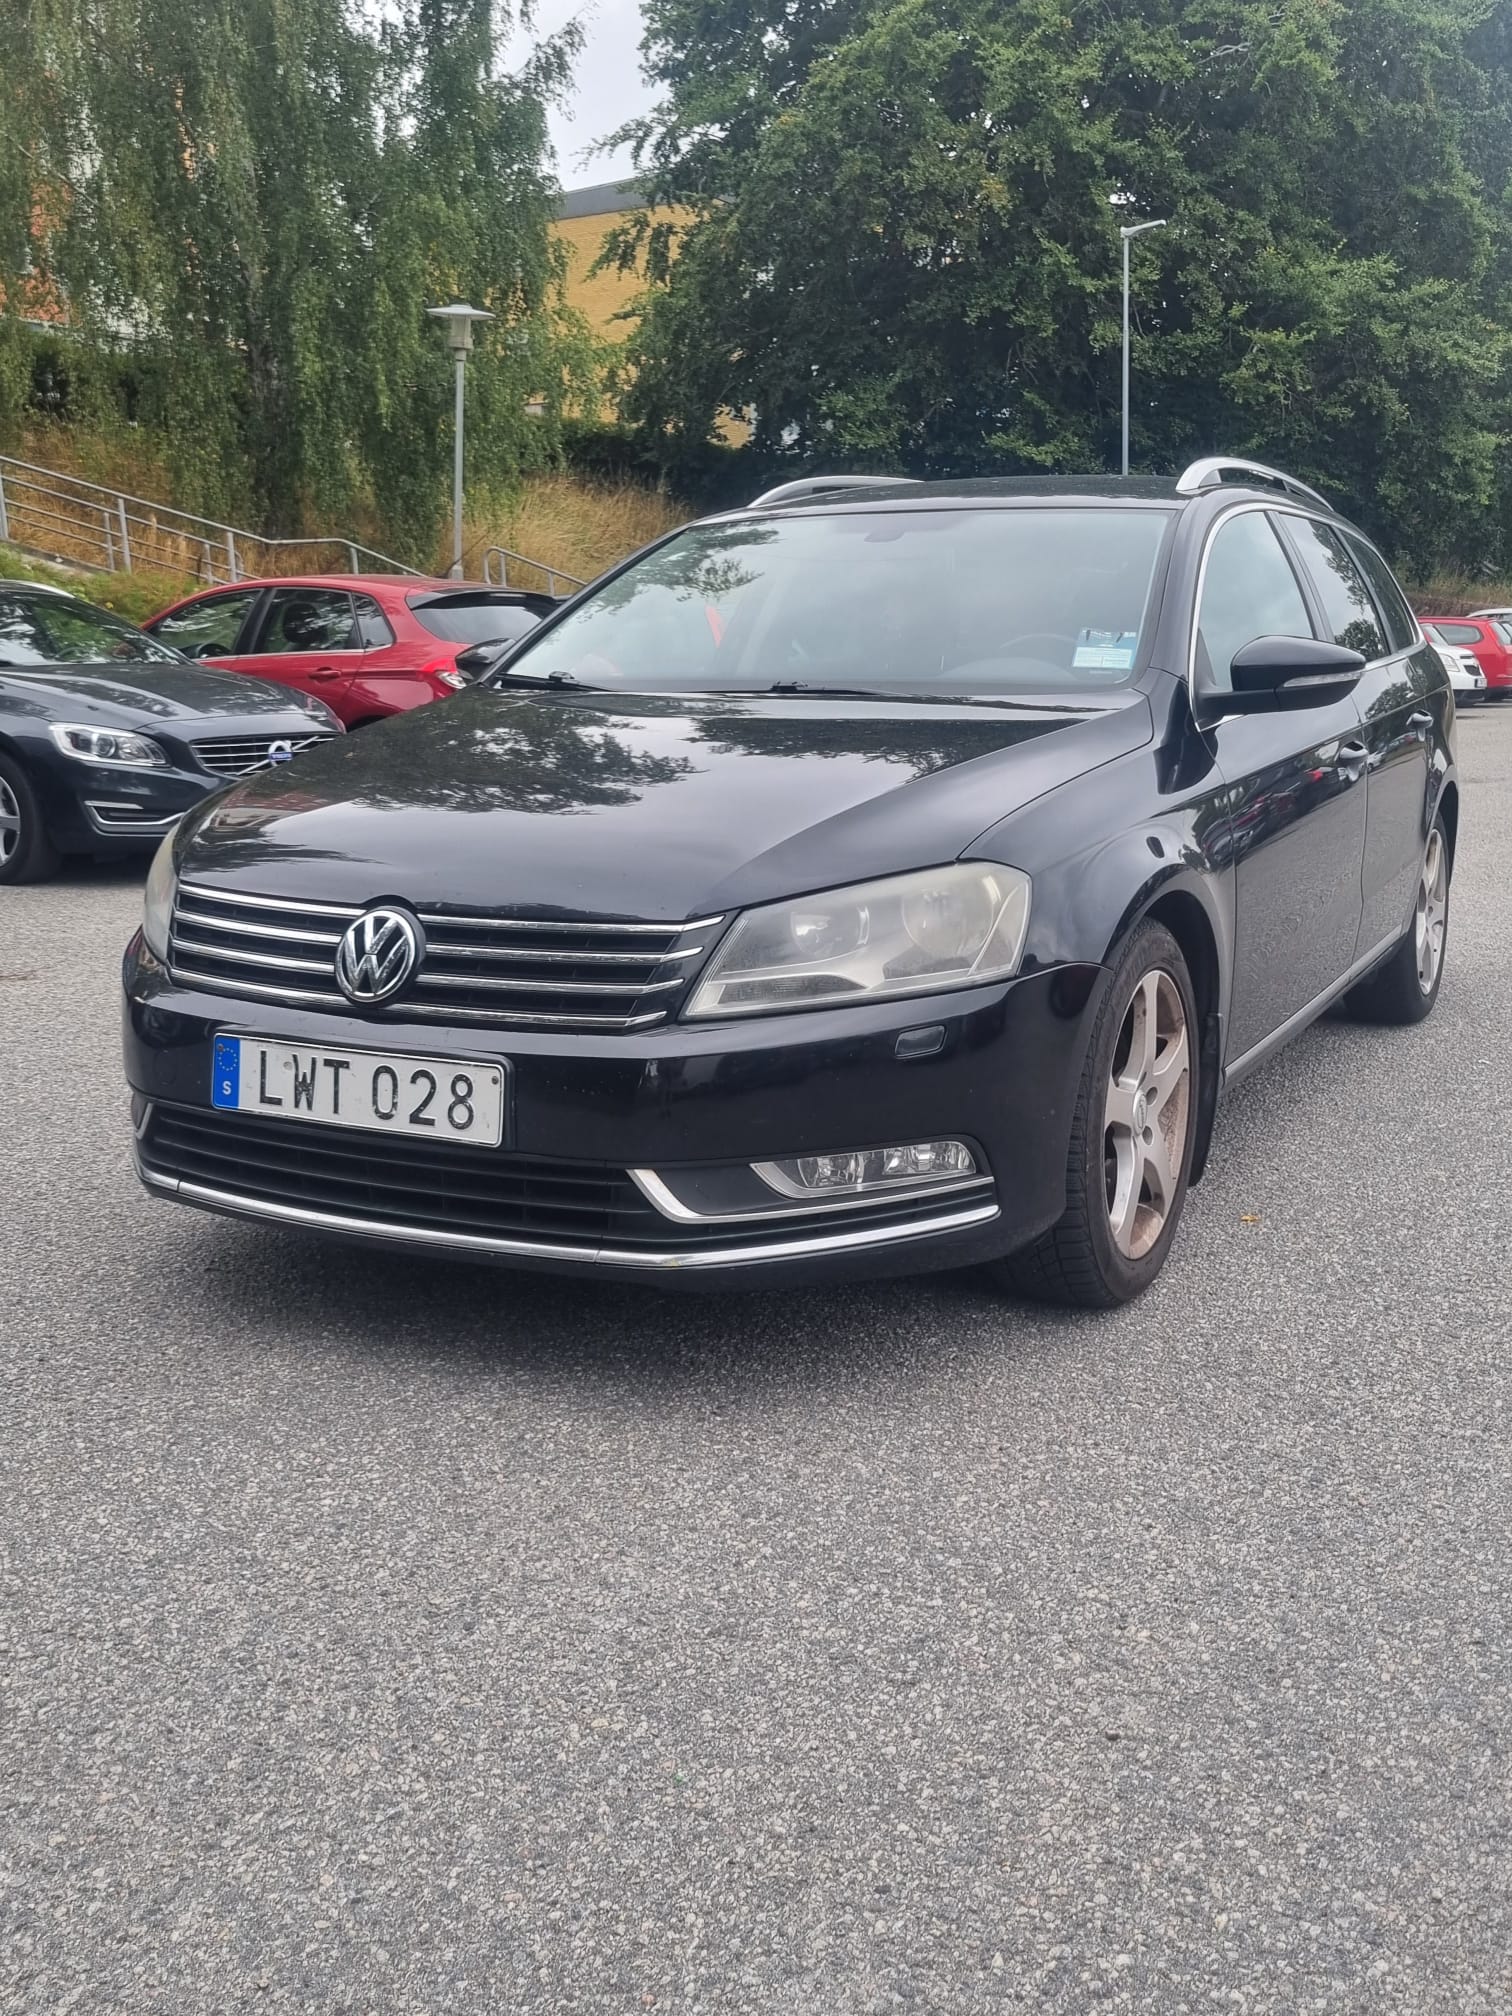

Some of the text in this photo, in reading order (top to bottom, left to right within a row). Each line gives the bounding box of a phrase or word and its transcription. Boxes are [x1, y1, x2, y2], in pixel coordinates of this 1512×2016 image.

[222, 1080, 232, 1096] S
[259, 1050, 475, 1131] LWT 028
